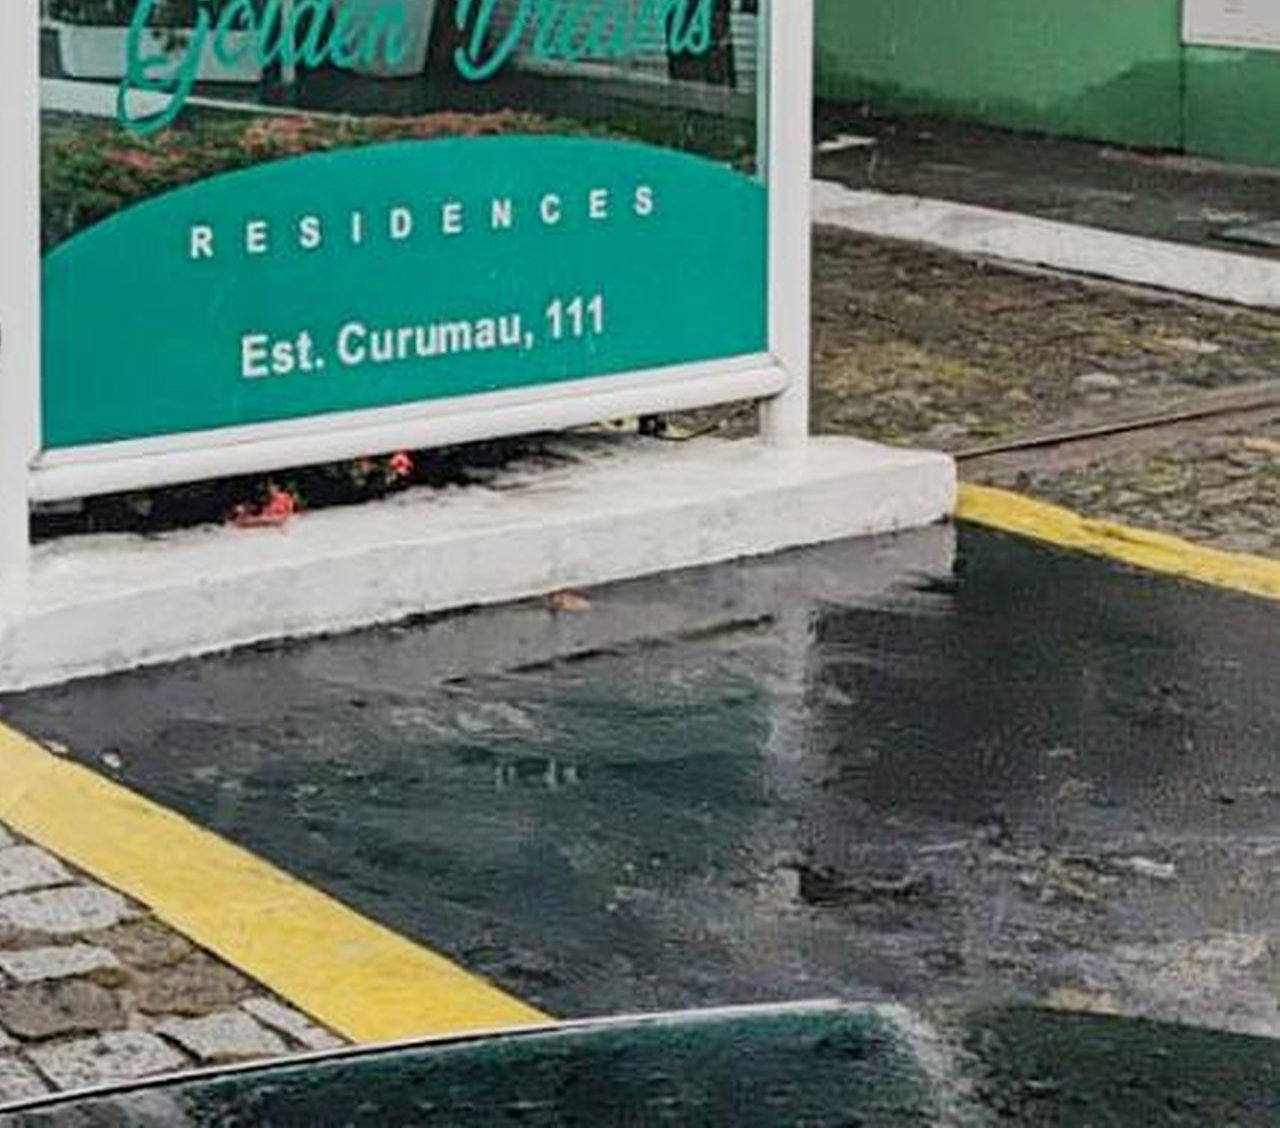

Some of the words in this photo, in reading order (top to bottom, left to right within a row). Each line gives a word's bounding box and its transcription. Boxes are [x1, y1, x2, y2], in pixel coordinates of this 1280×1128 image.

[189, 186, 656, 259] RESIDENCES
[240, 331, 325, 378] Est.
[339, 310, 534, 366] Curumau,
[545, 294, 606, 340] 111
